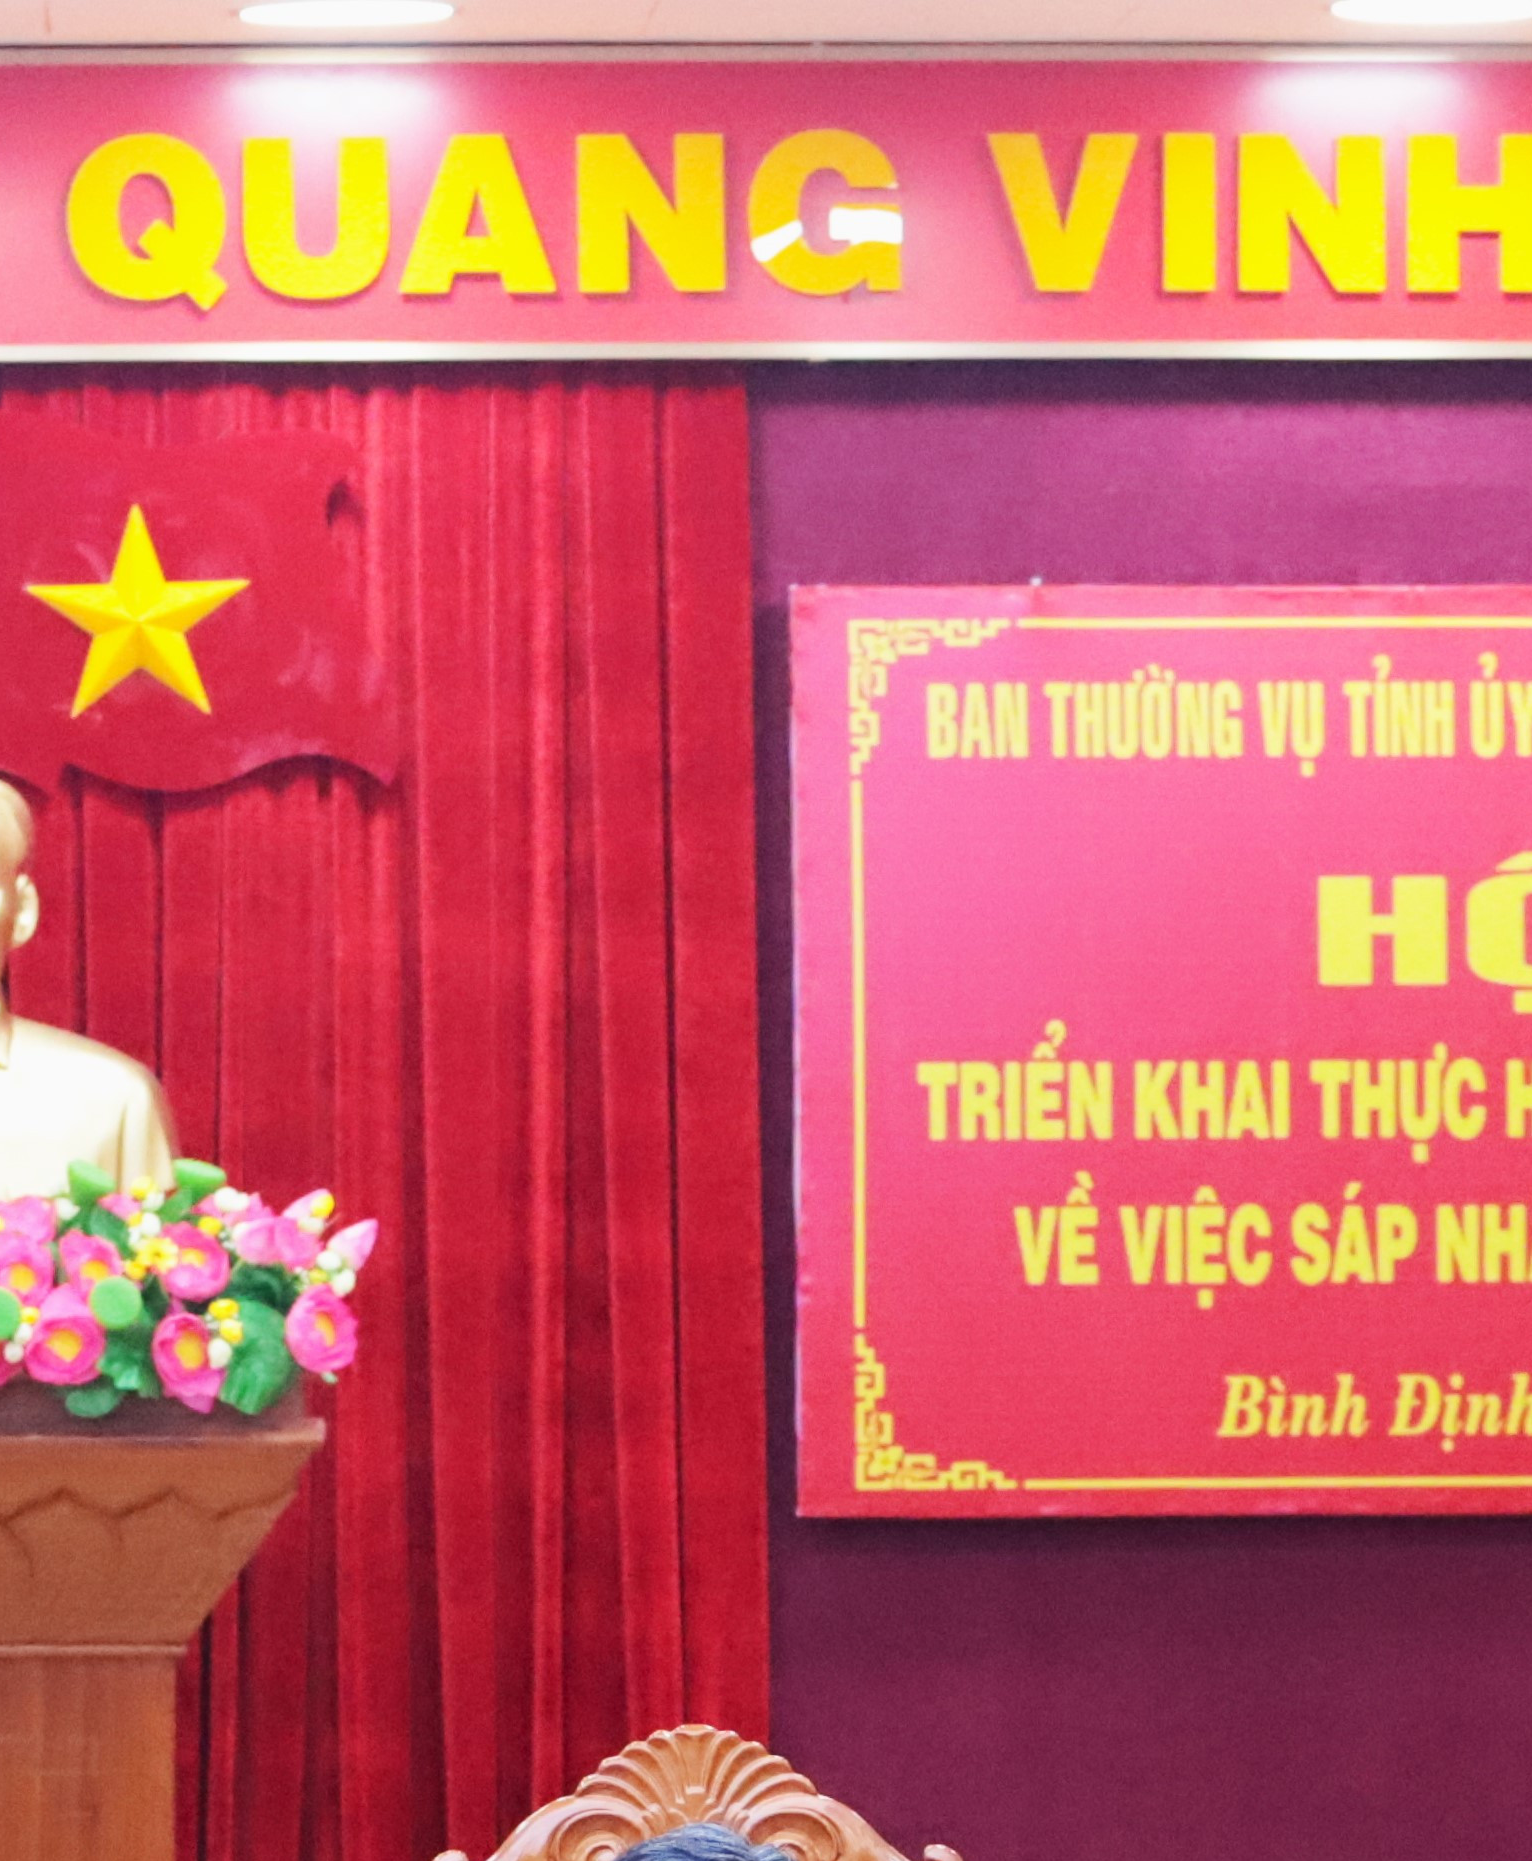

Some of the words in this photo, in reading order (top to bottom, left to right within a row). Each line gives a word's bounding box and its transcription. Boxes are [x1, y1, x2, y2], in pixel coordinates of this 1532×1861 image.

[66, 130, 903, 310] QUANG
[926, 682, 1029, 758] BAN
[1044, 664, 1243, 758] THƯỜNG
[1260, 682, 1325, 776] VỤ
[1344, 655, 1456, 757] TỈNH
[917, 1019, 1113, 1141] TRIỂN
[1134, 1059, 1292, 1140] KHAI
[1310, 1043, 1487, 1163] THỰC
[1015, 1170, 1100, 1286] VỀ
[1120, 1186, 1273, 1309] VIỆC
[1291, 1182, 1419, 1286] SÁP
[1218, 1373, 1368, 1438] Bình
